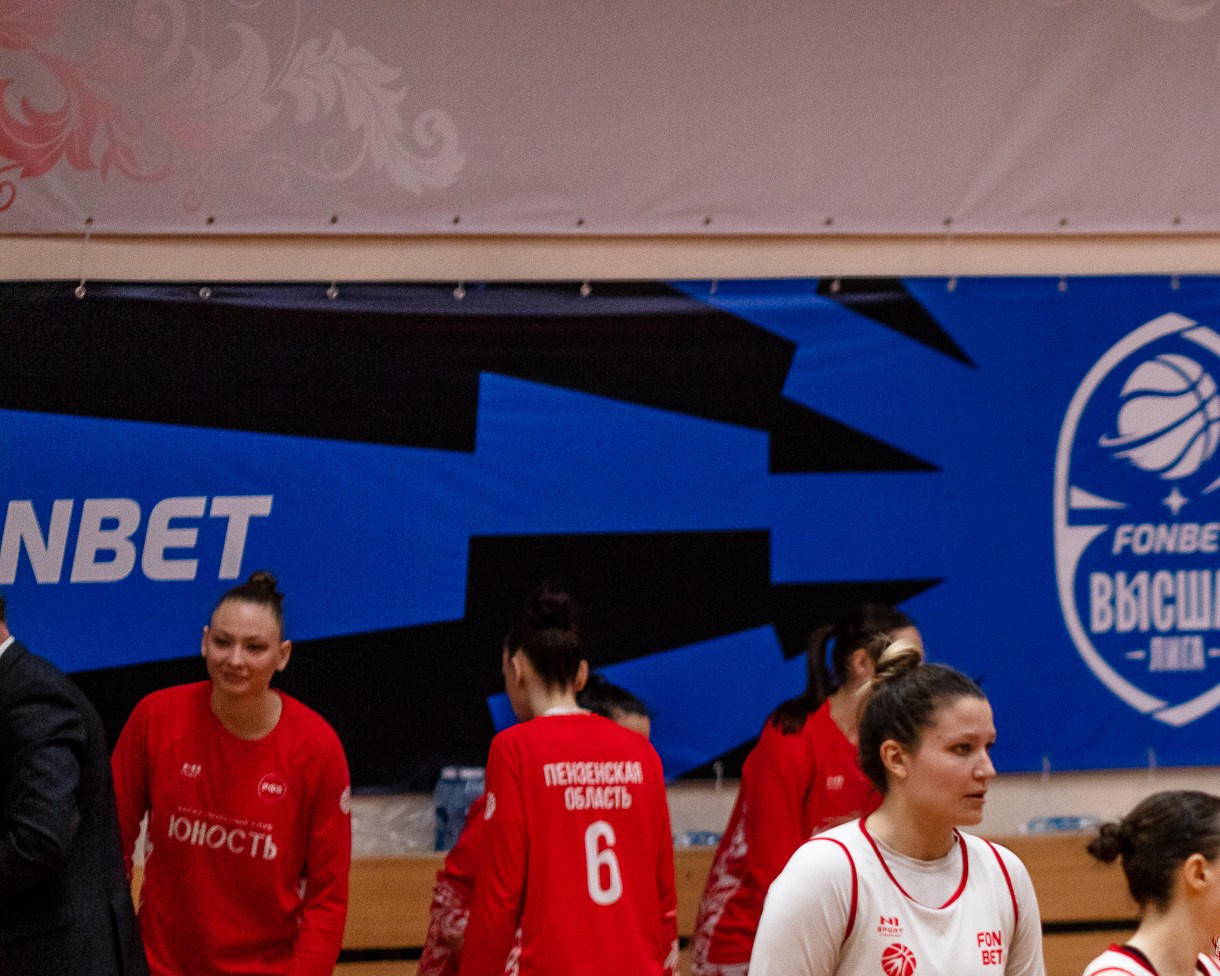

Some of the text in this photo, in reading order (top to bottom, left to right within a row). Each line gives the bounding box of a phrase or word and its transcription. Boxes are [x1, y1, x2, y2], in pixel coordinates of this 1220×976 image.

[0, 495, 273, 585] NBET
[543, 761, 644, 787] ПЕНЗЕНСКАЯ
[564, 786, 632, 811] ОБЛАСТЬ
[168, 814, 278, 861] ЮНОСТЬ
[585, 820, 623, 906] 6
[977, 930, 1002, 948] FON
[982, 949, 1003, 965] BET
